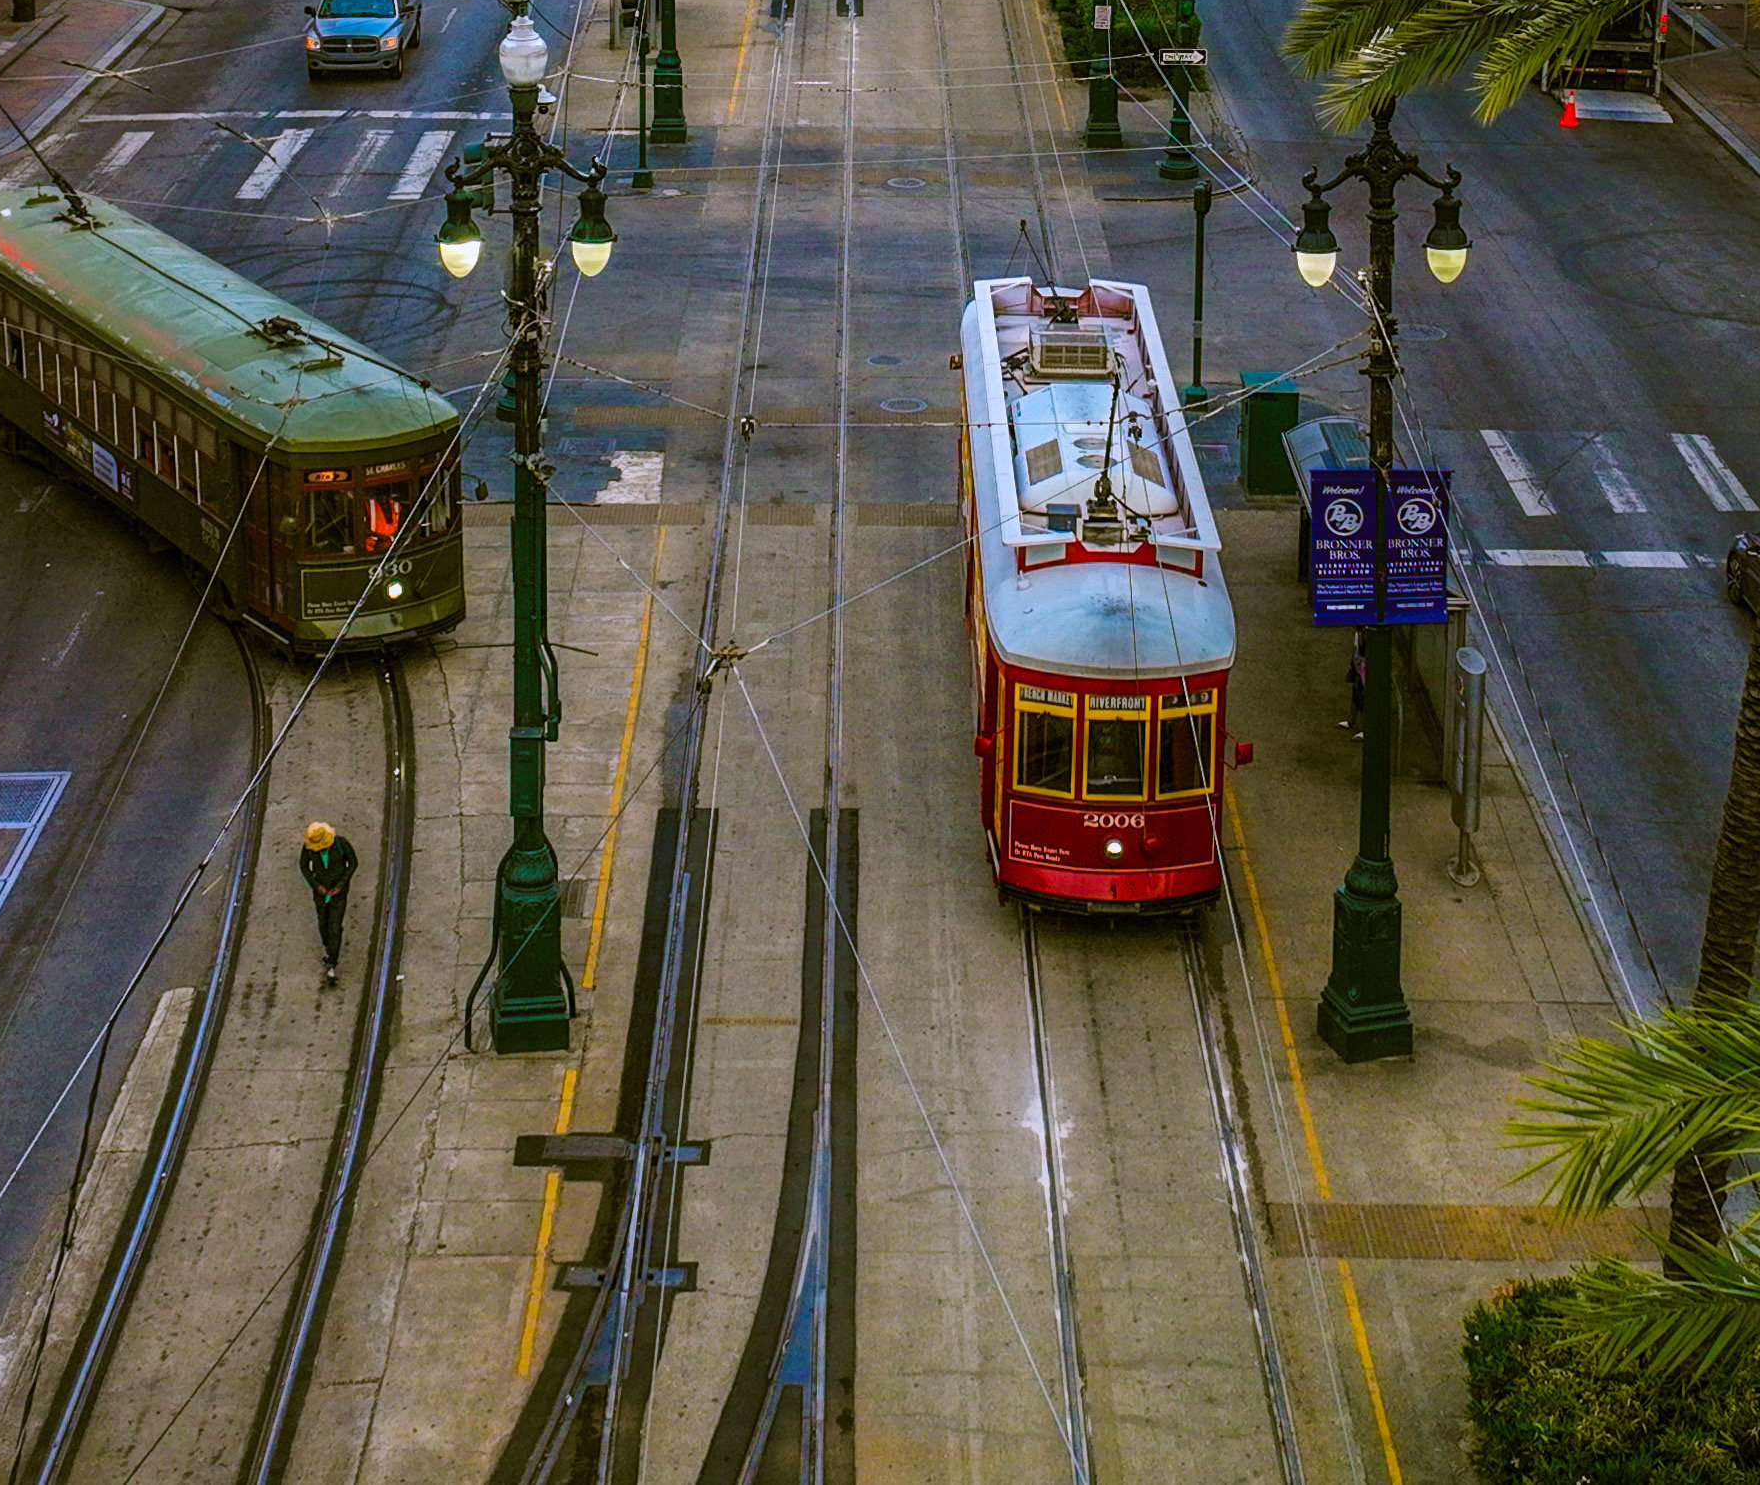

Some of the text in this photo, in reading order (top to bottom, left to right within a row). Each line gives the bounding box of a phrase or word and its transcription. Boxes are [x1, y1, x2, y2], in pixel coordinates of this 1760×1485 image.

[1322, 485, 1365, 495] Welcome!
[1316, 539, 1374, 550] BRONNER
[1388, 538, 1444, 549] BRONNER
[1329, 549, 1361, 560] BROS.
[368, 561, 412, 579] 930
[1020, 686, 1073, 706] FRENCH MARKET
[1090, 696, 1145, 709] RIVERFRONT
[1084, 815, 1144, 828] 2006
